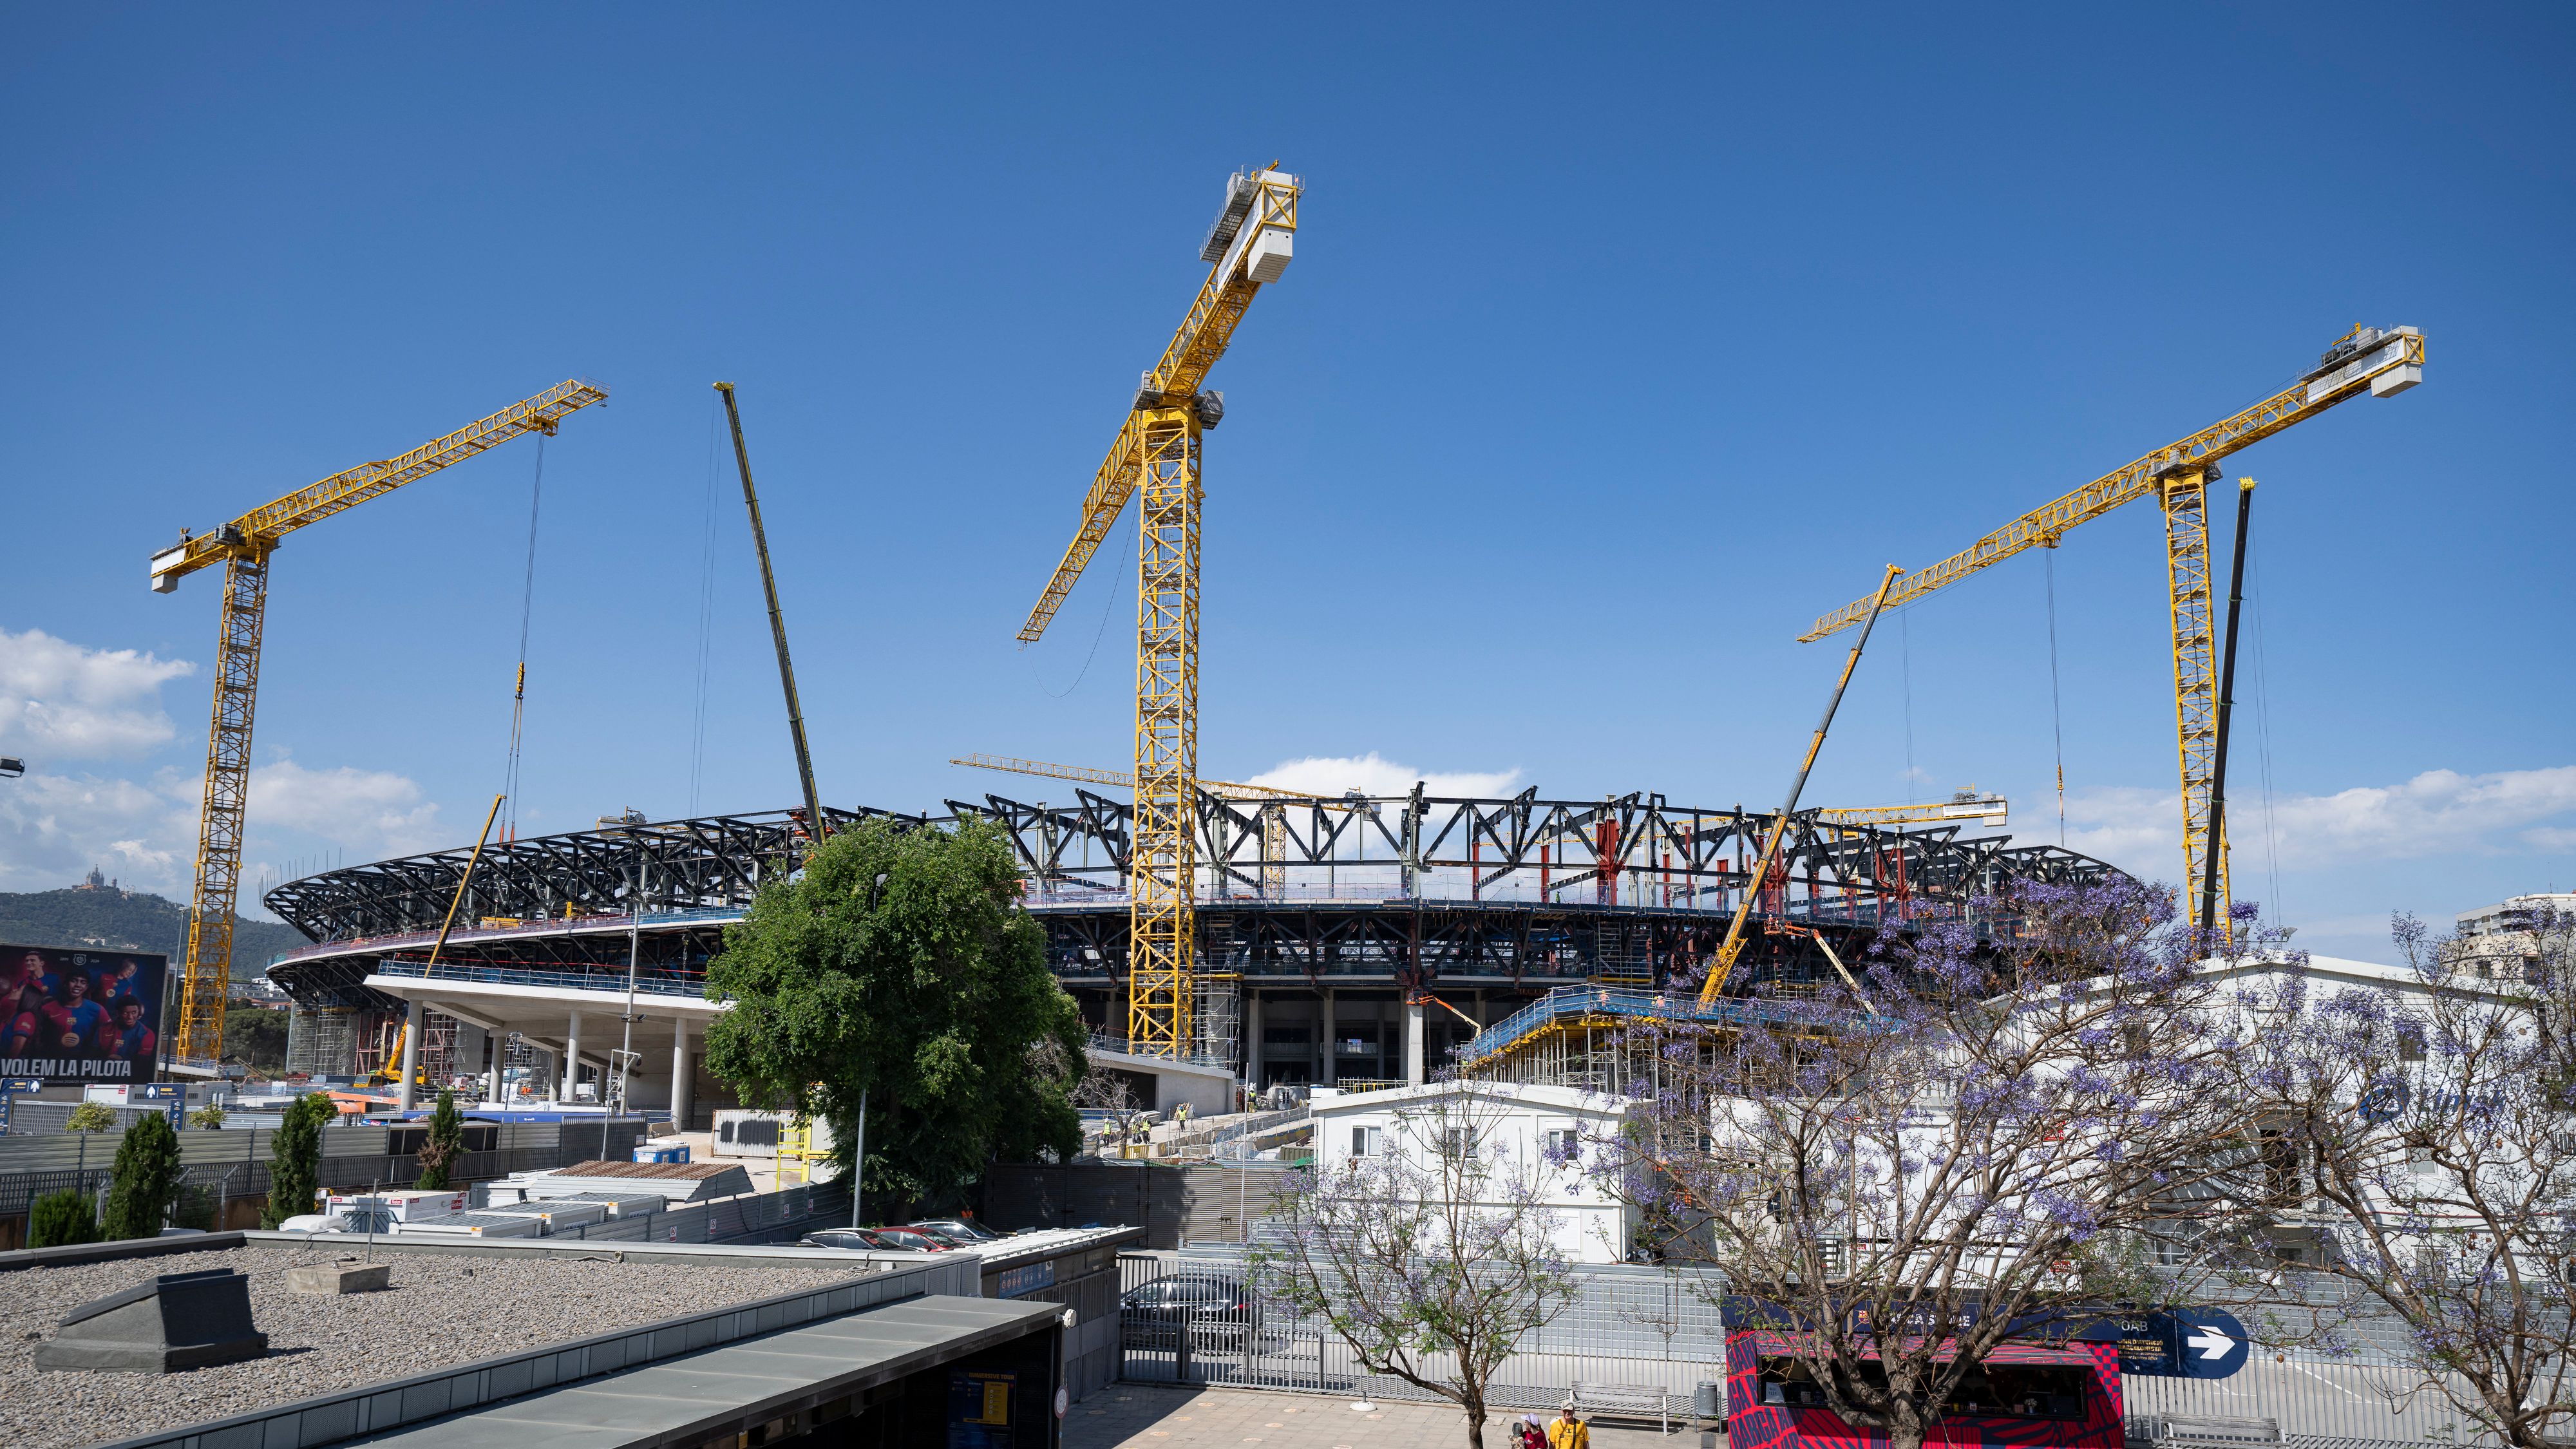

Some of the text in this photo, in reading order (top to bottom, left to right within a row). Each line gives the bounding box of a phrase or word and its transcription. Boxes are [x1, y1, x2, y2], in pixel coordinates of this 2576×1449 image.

[396, 1034, 404, 1048] RAYO
[1, 1058, 131, 1077] VOLEM LA PILOTA
[2121, 1320, 2148, 1331] OAB
